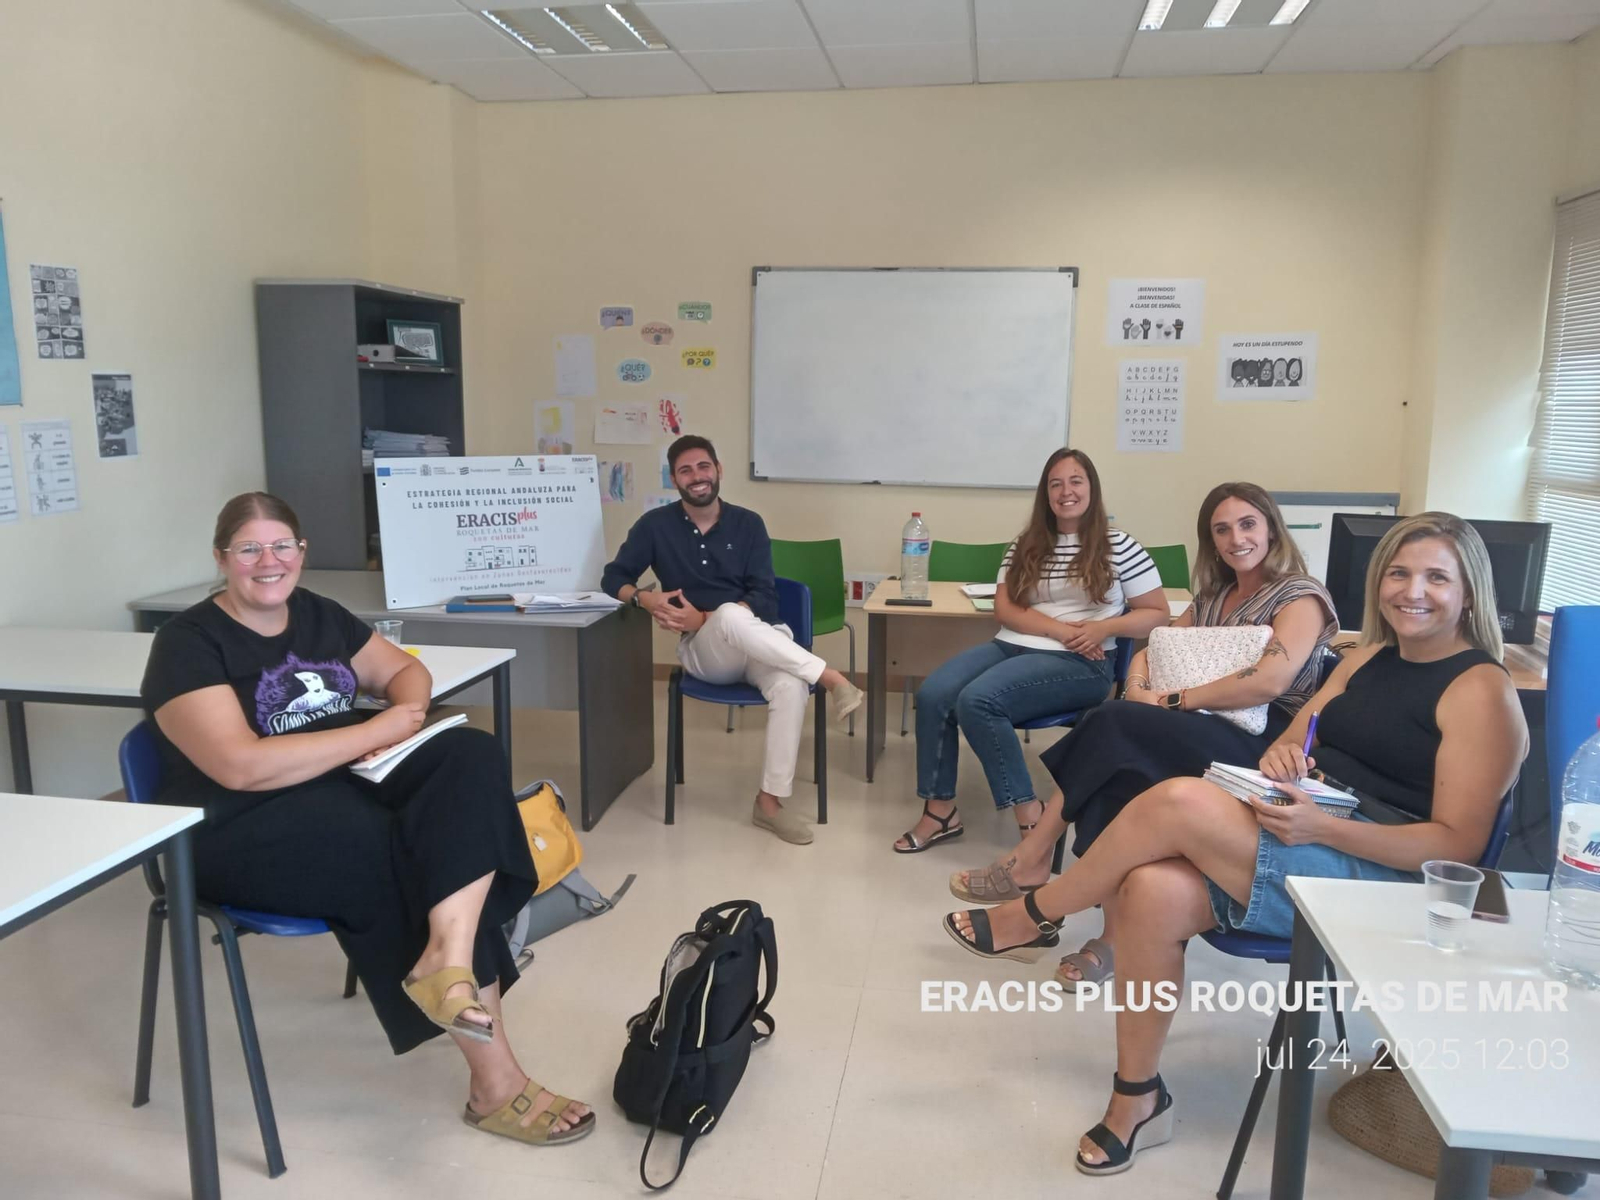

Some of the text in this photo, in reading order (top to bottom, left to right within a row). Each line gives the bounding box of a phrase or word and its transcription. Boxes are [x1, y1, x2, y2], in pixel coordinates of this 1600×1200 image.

[621, 363, 646, 373] ¿QUÉ?
[407, 489, 461, 498] ESTRATEGIA
[511, 486, 552, 494] ANDALUZA
[427, 500, 470, 508] COHESIÓN
[498, 497, 542, 505] INCLUSIÓN
[456, 506, 537, 528] ERACIS plus
[456, 527, 502, 536] ROQUETAS
